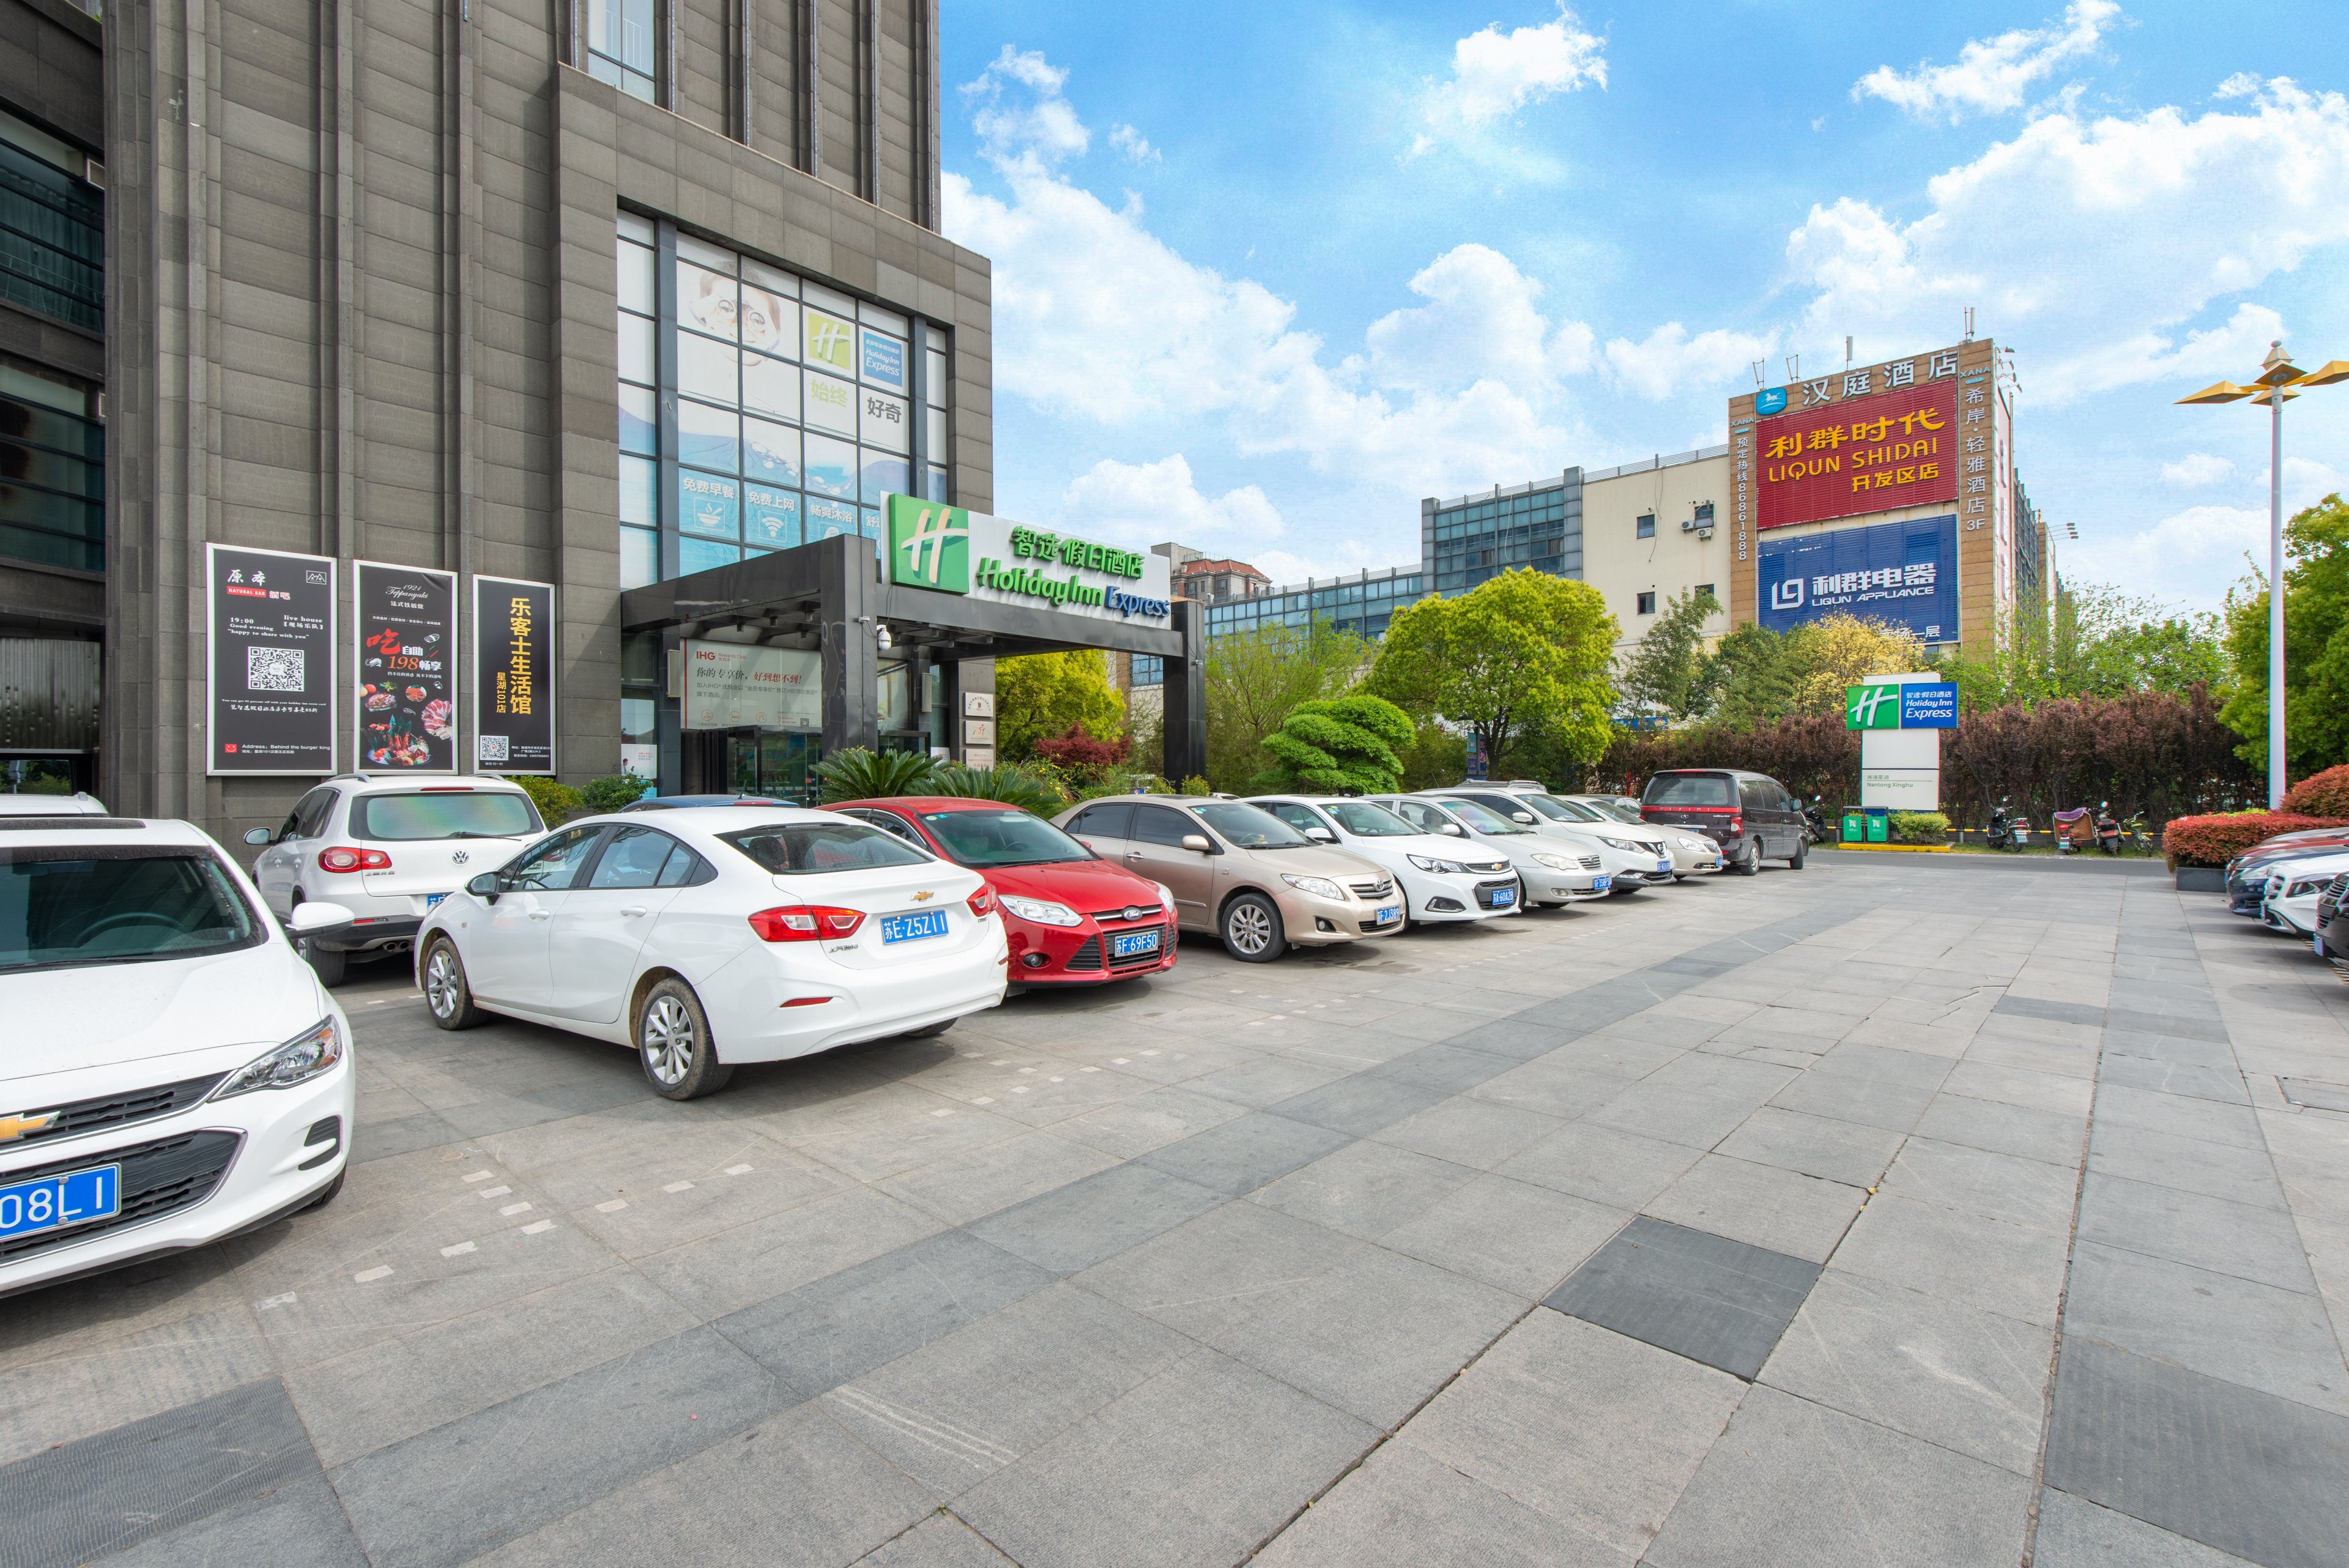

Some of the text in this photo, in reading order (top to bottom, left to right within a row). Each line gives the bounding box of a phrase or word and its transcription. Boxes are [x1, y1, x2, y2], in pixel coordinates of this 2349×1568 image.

[866, 347, 900, 365] Holiday Inn
[866, 357, 900, 376] Express
[1802, 351, 1958, 406] 汉庭酒店
[1959, 367, 1991, 378] XANA
[810, 378, 902, 423] 始终 好奇
[1731, 417, 1754, 427] XANA
[1765, 407, 1945, 459] 利群时代
[1768, 437, 1938, 483] LIQUN SHIDAI
[683, 477, 735, 500] 免费早餐
[1852, 463, 1939, 492] 开发区店
[749, 491, 795, 512] 免费上网
[811, 503, 853, 524] 畅爽沐浴
[1011, 524, 1145, 579] 智选假日酒店
[977, 557, 1170, 618] Holiday Inn Express
[1812, 563, 1937, 596] 利群电器
[269, 590, 291, 600] 酒吧
[385, 586, 429, 600] Teppanyaki
[1812, 585, 1934, 608] LIQUN APPLIANCE
[390, 601, 424, 609] 法式铁板烧
[366, 628, 401, 655] 吃
[402, 645, 423, 656] 自助
[510, 597, 532, 715] 乐客士生活馆
[696, 651, 716, 661] IHG
[496, 672, 507, 714] 星湖101店
[1906, 698, 1953, 708] Holiday Inn
[1906, 708, 1953, 720] Express
